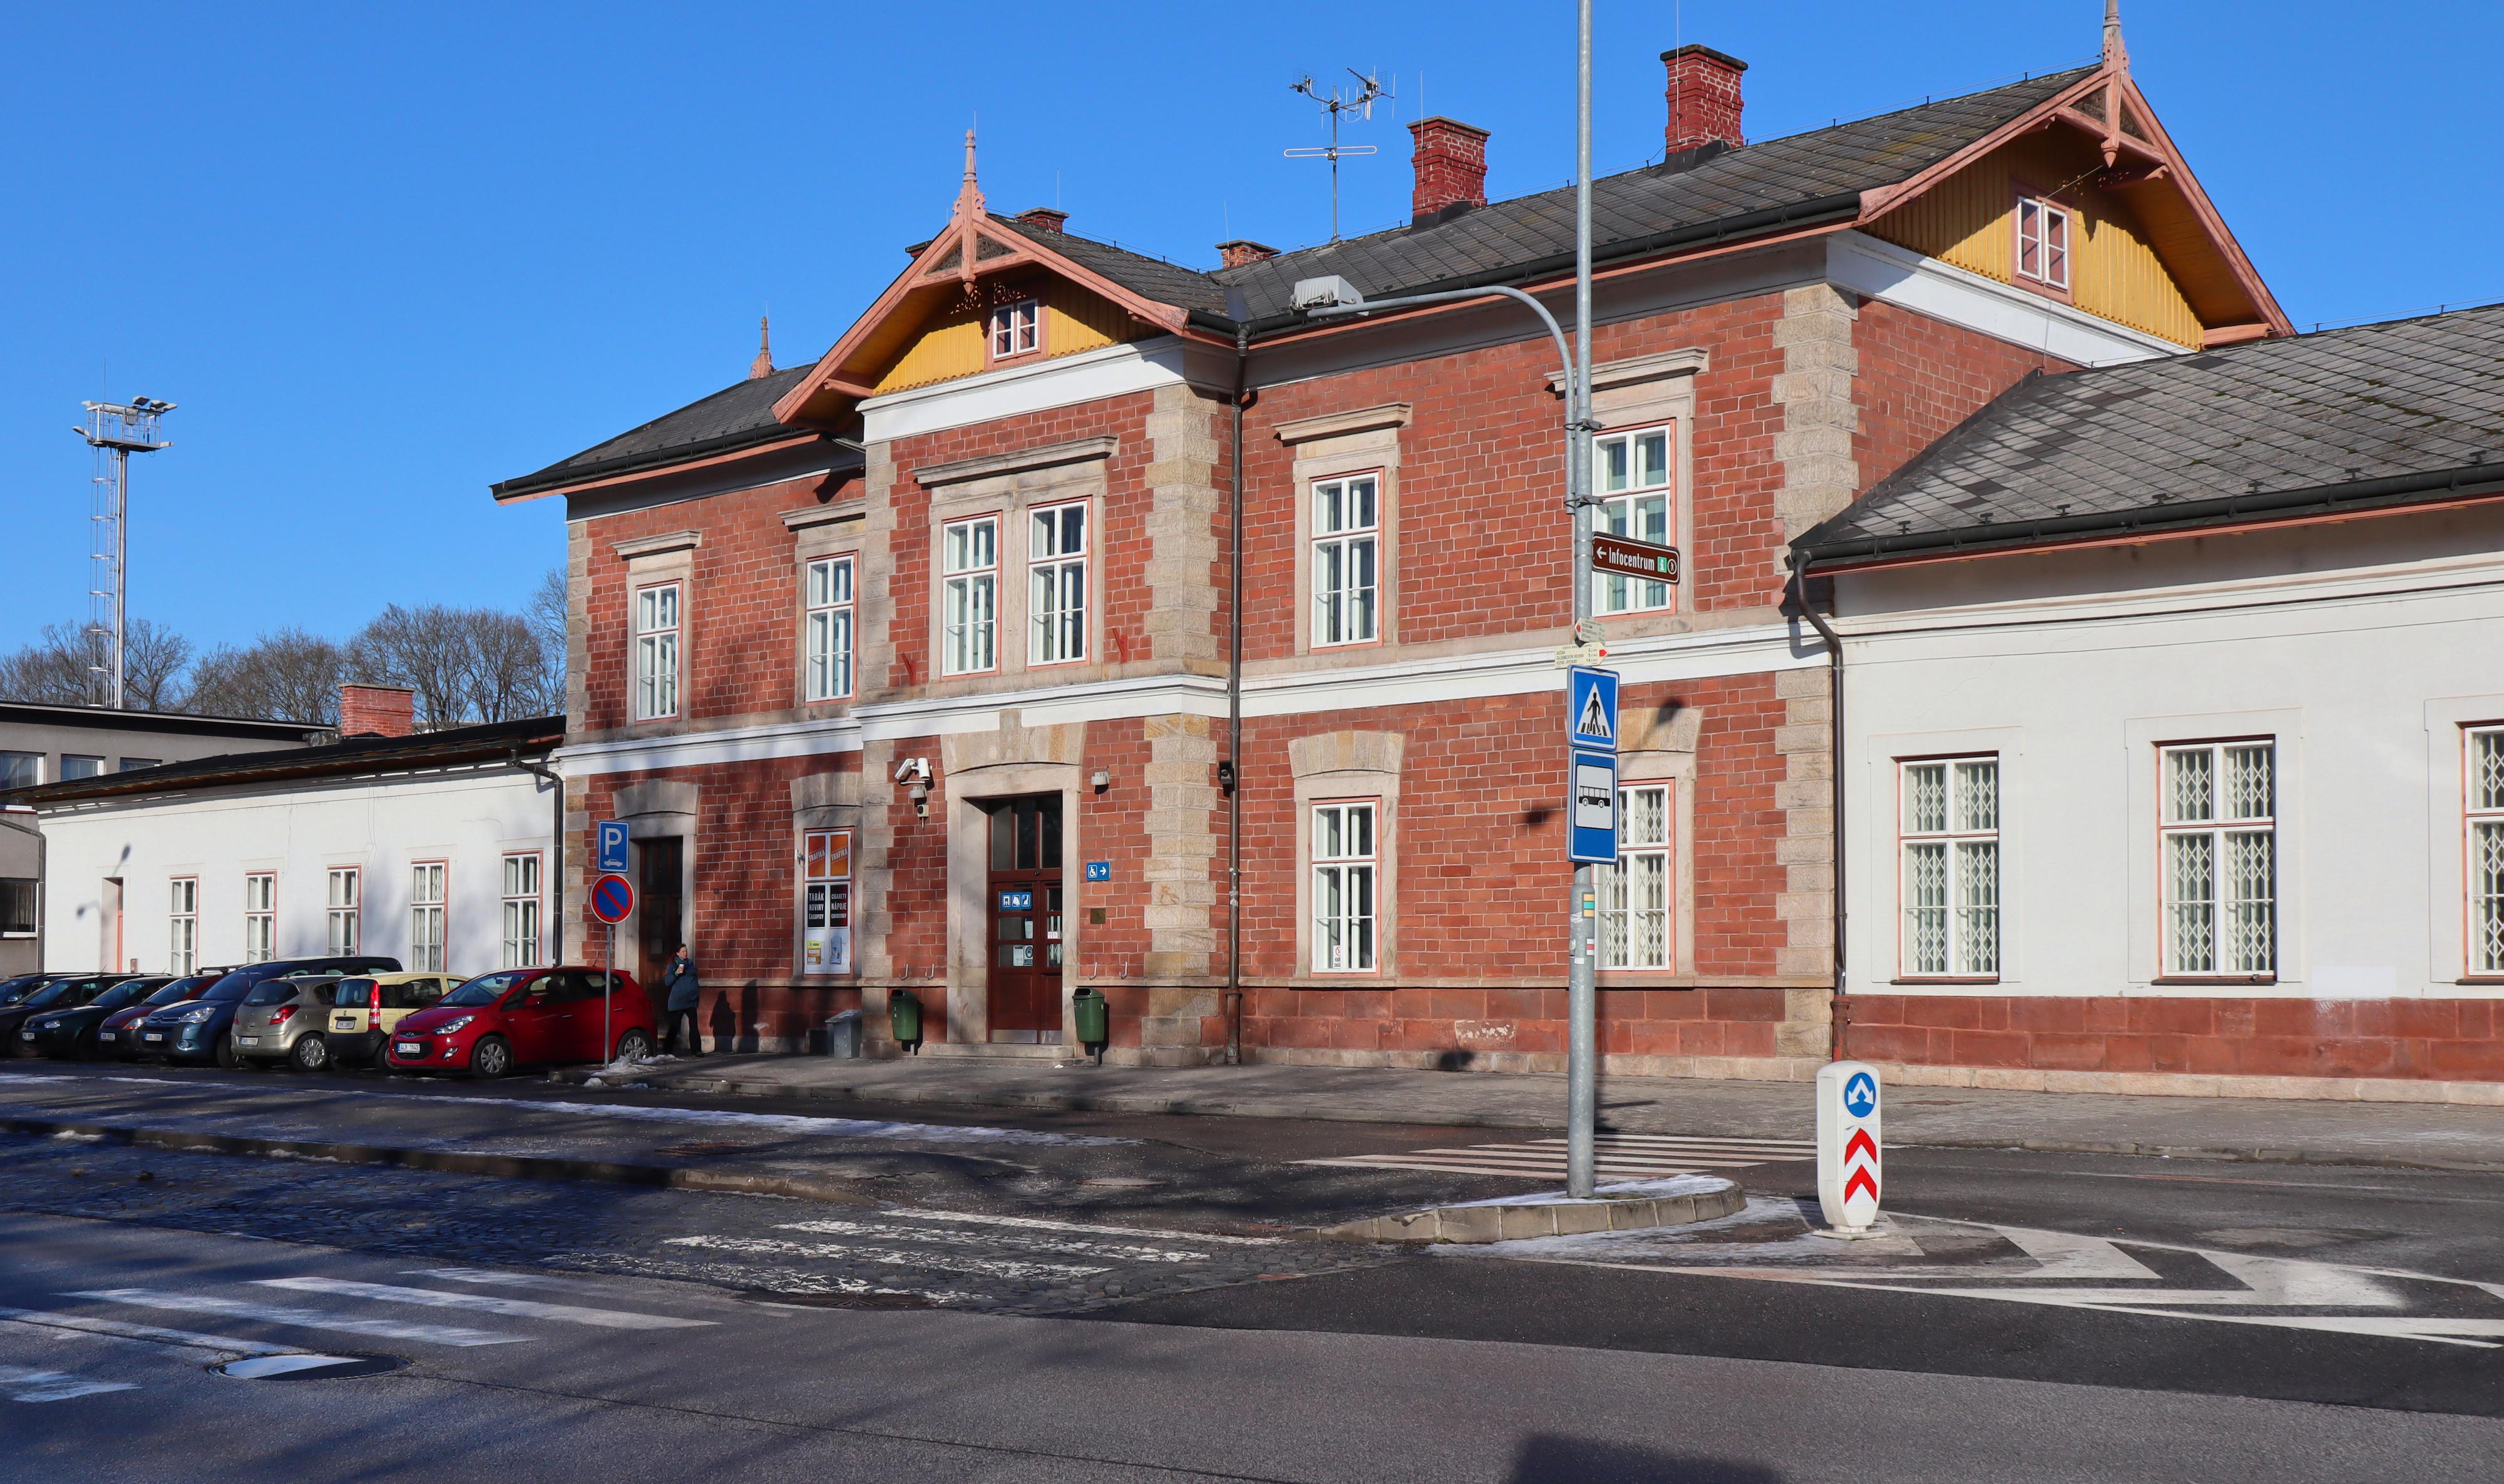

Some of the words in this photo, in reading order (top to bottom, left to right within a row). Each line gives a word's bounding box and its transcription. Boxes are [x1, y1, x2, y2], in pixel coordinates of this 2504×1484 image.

[1608, 546, 1655, 571] Infocentrum
[605, 827, 622, 856] P
[809, 849, 825, 862] TRAFIKA
[831, 847, 848, 861] TRAFIKA
[809, 891, 824, 901] TABÁK
[809, 903, 824, 911] NOVINY
[831, 901, 847, 910] NÁPOJE
